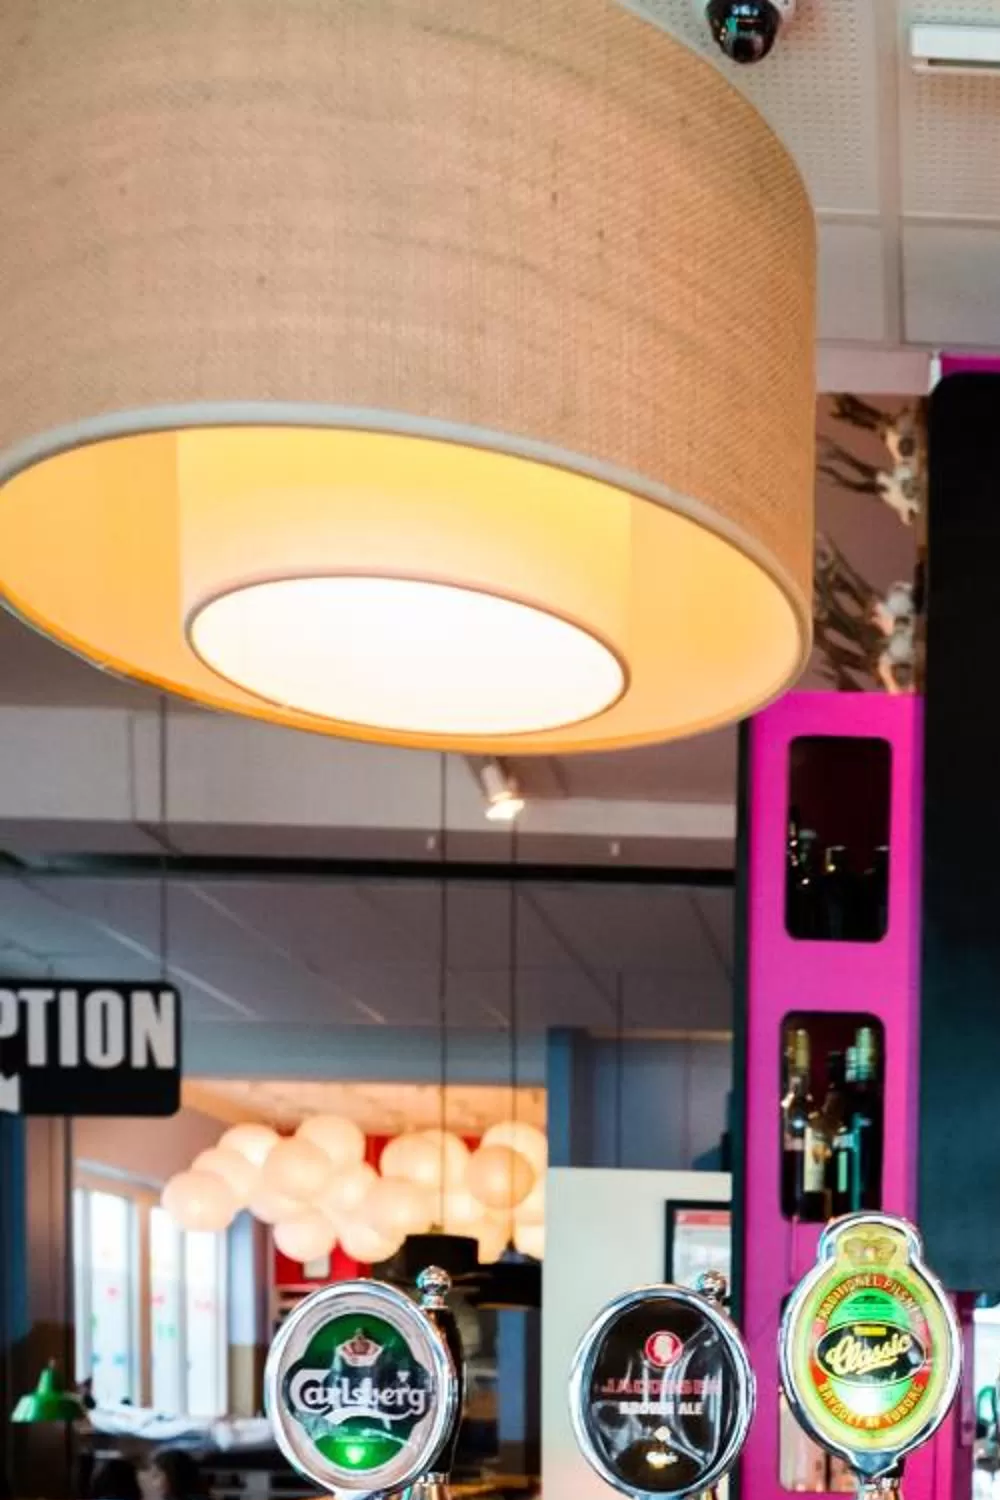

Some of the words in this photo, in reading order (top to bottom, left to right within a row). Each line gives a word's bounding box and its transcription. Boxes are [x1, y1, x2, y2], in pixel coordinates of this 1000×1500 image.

[825, 1333, 913, 1375] Classic
[290, 1368, 427, 1424] Carlsberg
[678, 1401, 703, 1415] ALE
